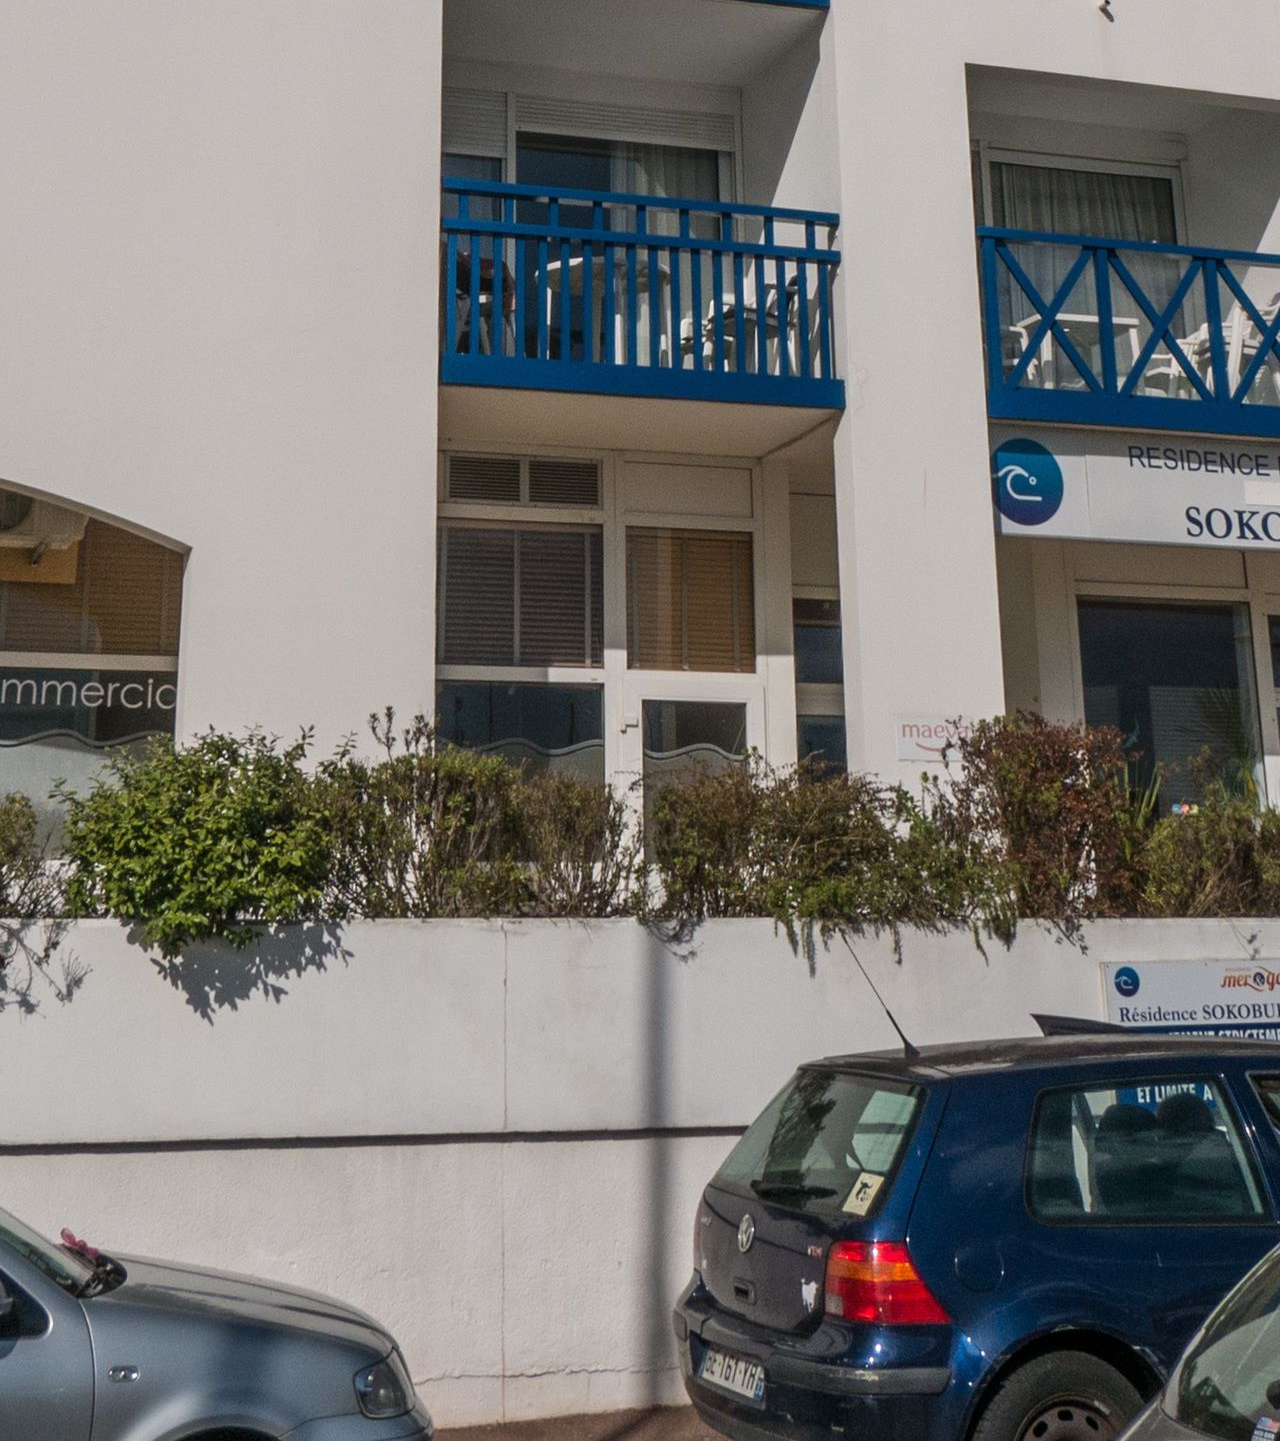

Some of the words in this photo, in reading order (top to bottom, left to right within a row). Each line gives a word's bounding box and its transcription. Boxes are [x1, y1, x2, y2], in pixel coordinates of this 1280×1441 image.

[1128, 445, 1270, 477] RESIDENCE
[902, 724, 969, 739] maeva
[1221, 974, 1257, 989] mer
[1120, 1006, 1197, 1023] Résidence
[1137, 1086, 1151, 1103] ET
[1203, 1084, 1213, 1101] A
